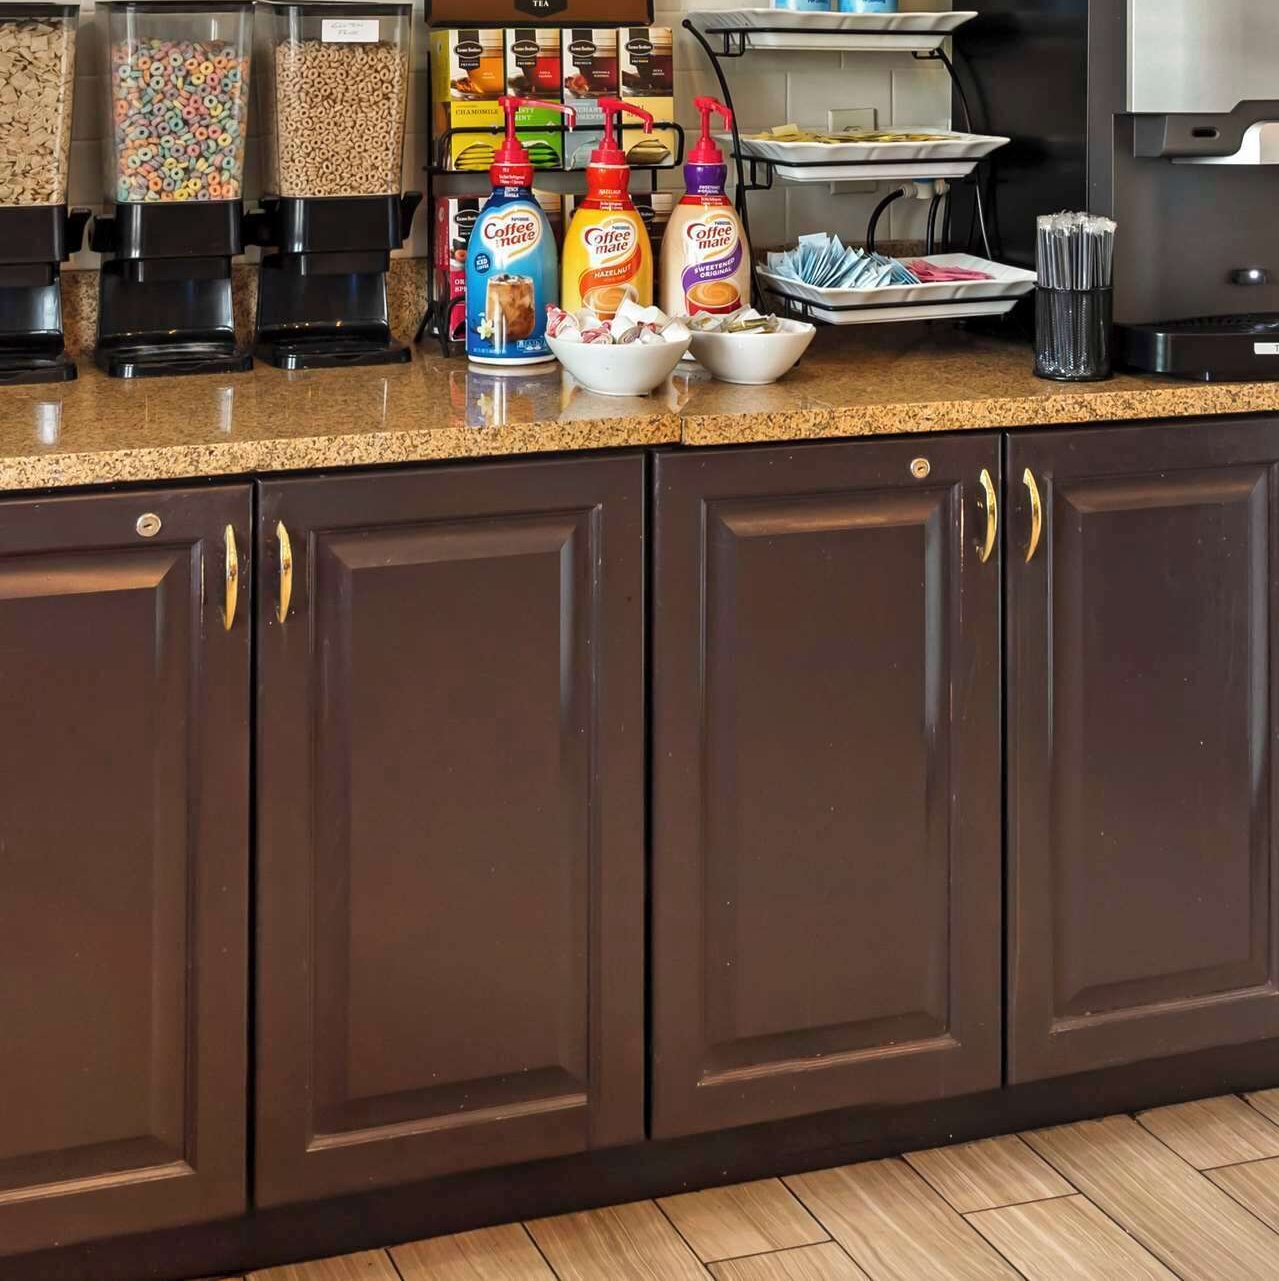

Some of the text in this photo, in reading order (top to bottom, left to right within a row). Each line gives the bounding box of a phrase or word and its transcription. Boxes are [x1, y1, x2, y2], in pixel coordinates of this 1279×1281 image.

[484, 222, 535, 239] Coffee
[584, 227, 631, 246] Coffee
[686, 222, 732, 240] Coffee
[595, 241, 628, 255] mate
[698, 236, 731, 250] mate
[476, 258, 488, 266] ICED
[694, 257, 735, 274] SWEETENED
[594, 264, 632, 279] HAZELNUT
[700, 267, 732, 278] ORIGINAL
